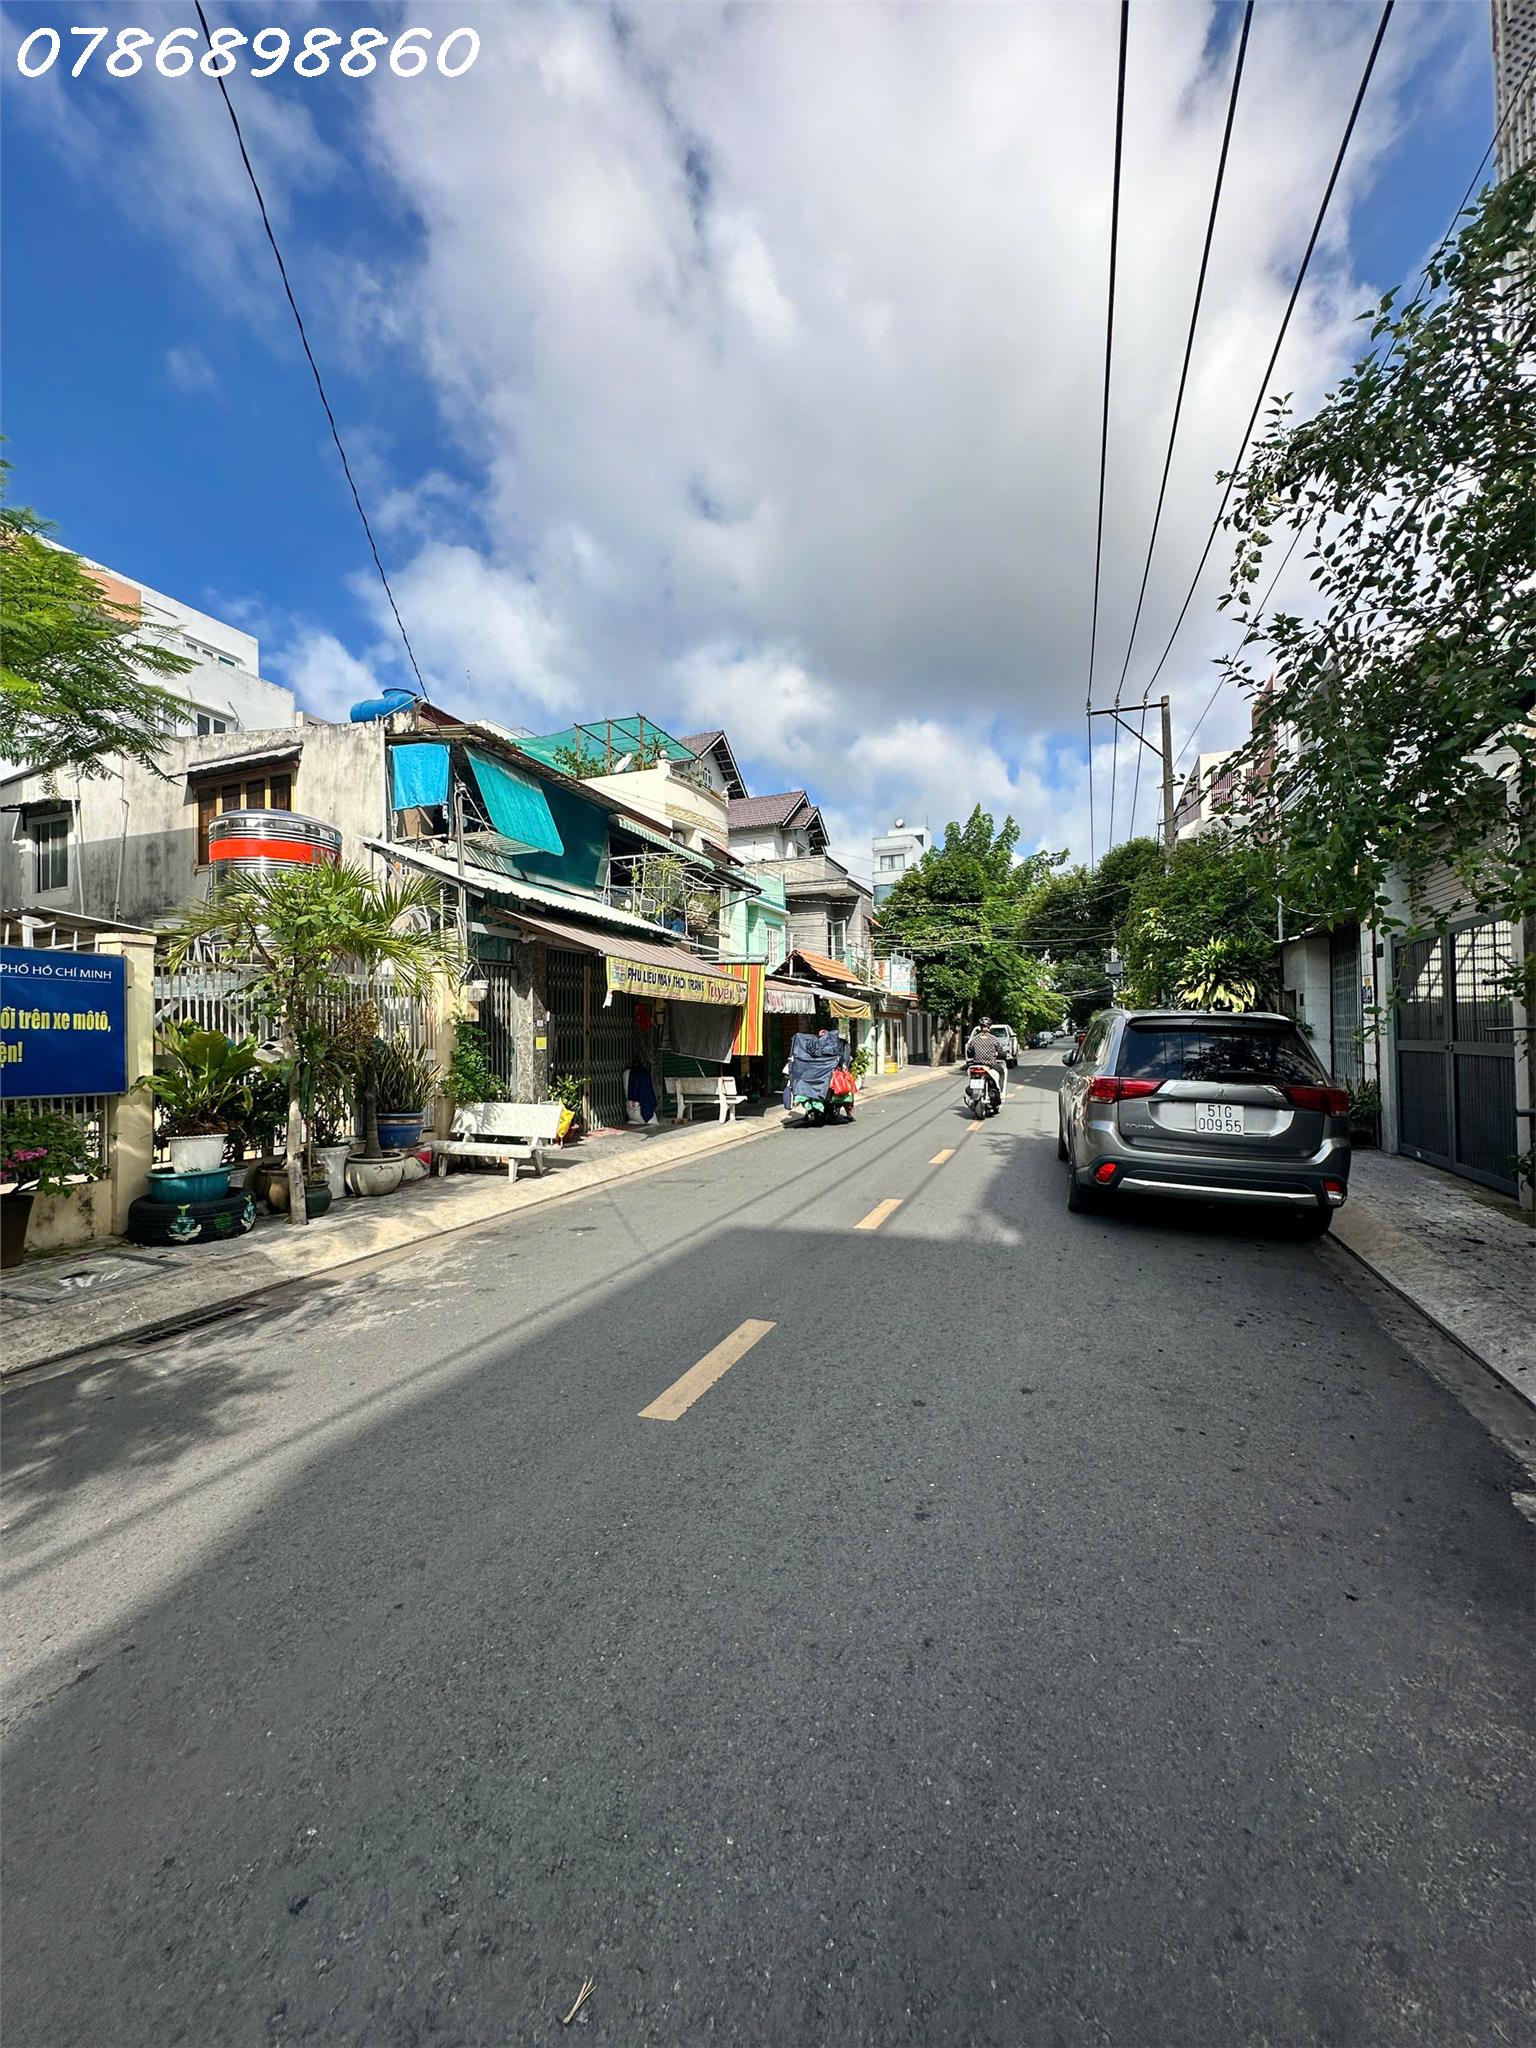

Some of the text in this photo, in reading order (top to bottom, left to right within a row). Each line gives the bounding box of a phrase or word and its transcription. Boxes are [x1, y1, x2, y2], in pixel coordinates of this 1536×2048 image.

[55, 966, 77, 977] CHÍ
[79, 969, 112, 979] MINH
[18, 1008, 51, 1030] trên
[53, 1012, 71, 1030] xe
[1207, 1104, 1232, 1118] 51G
